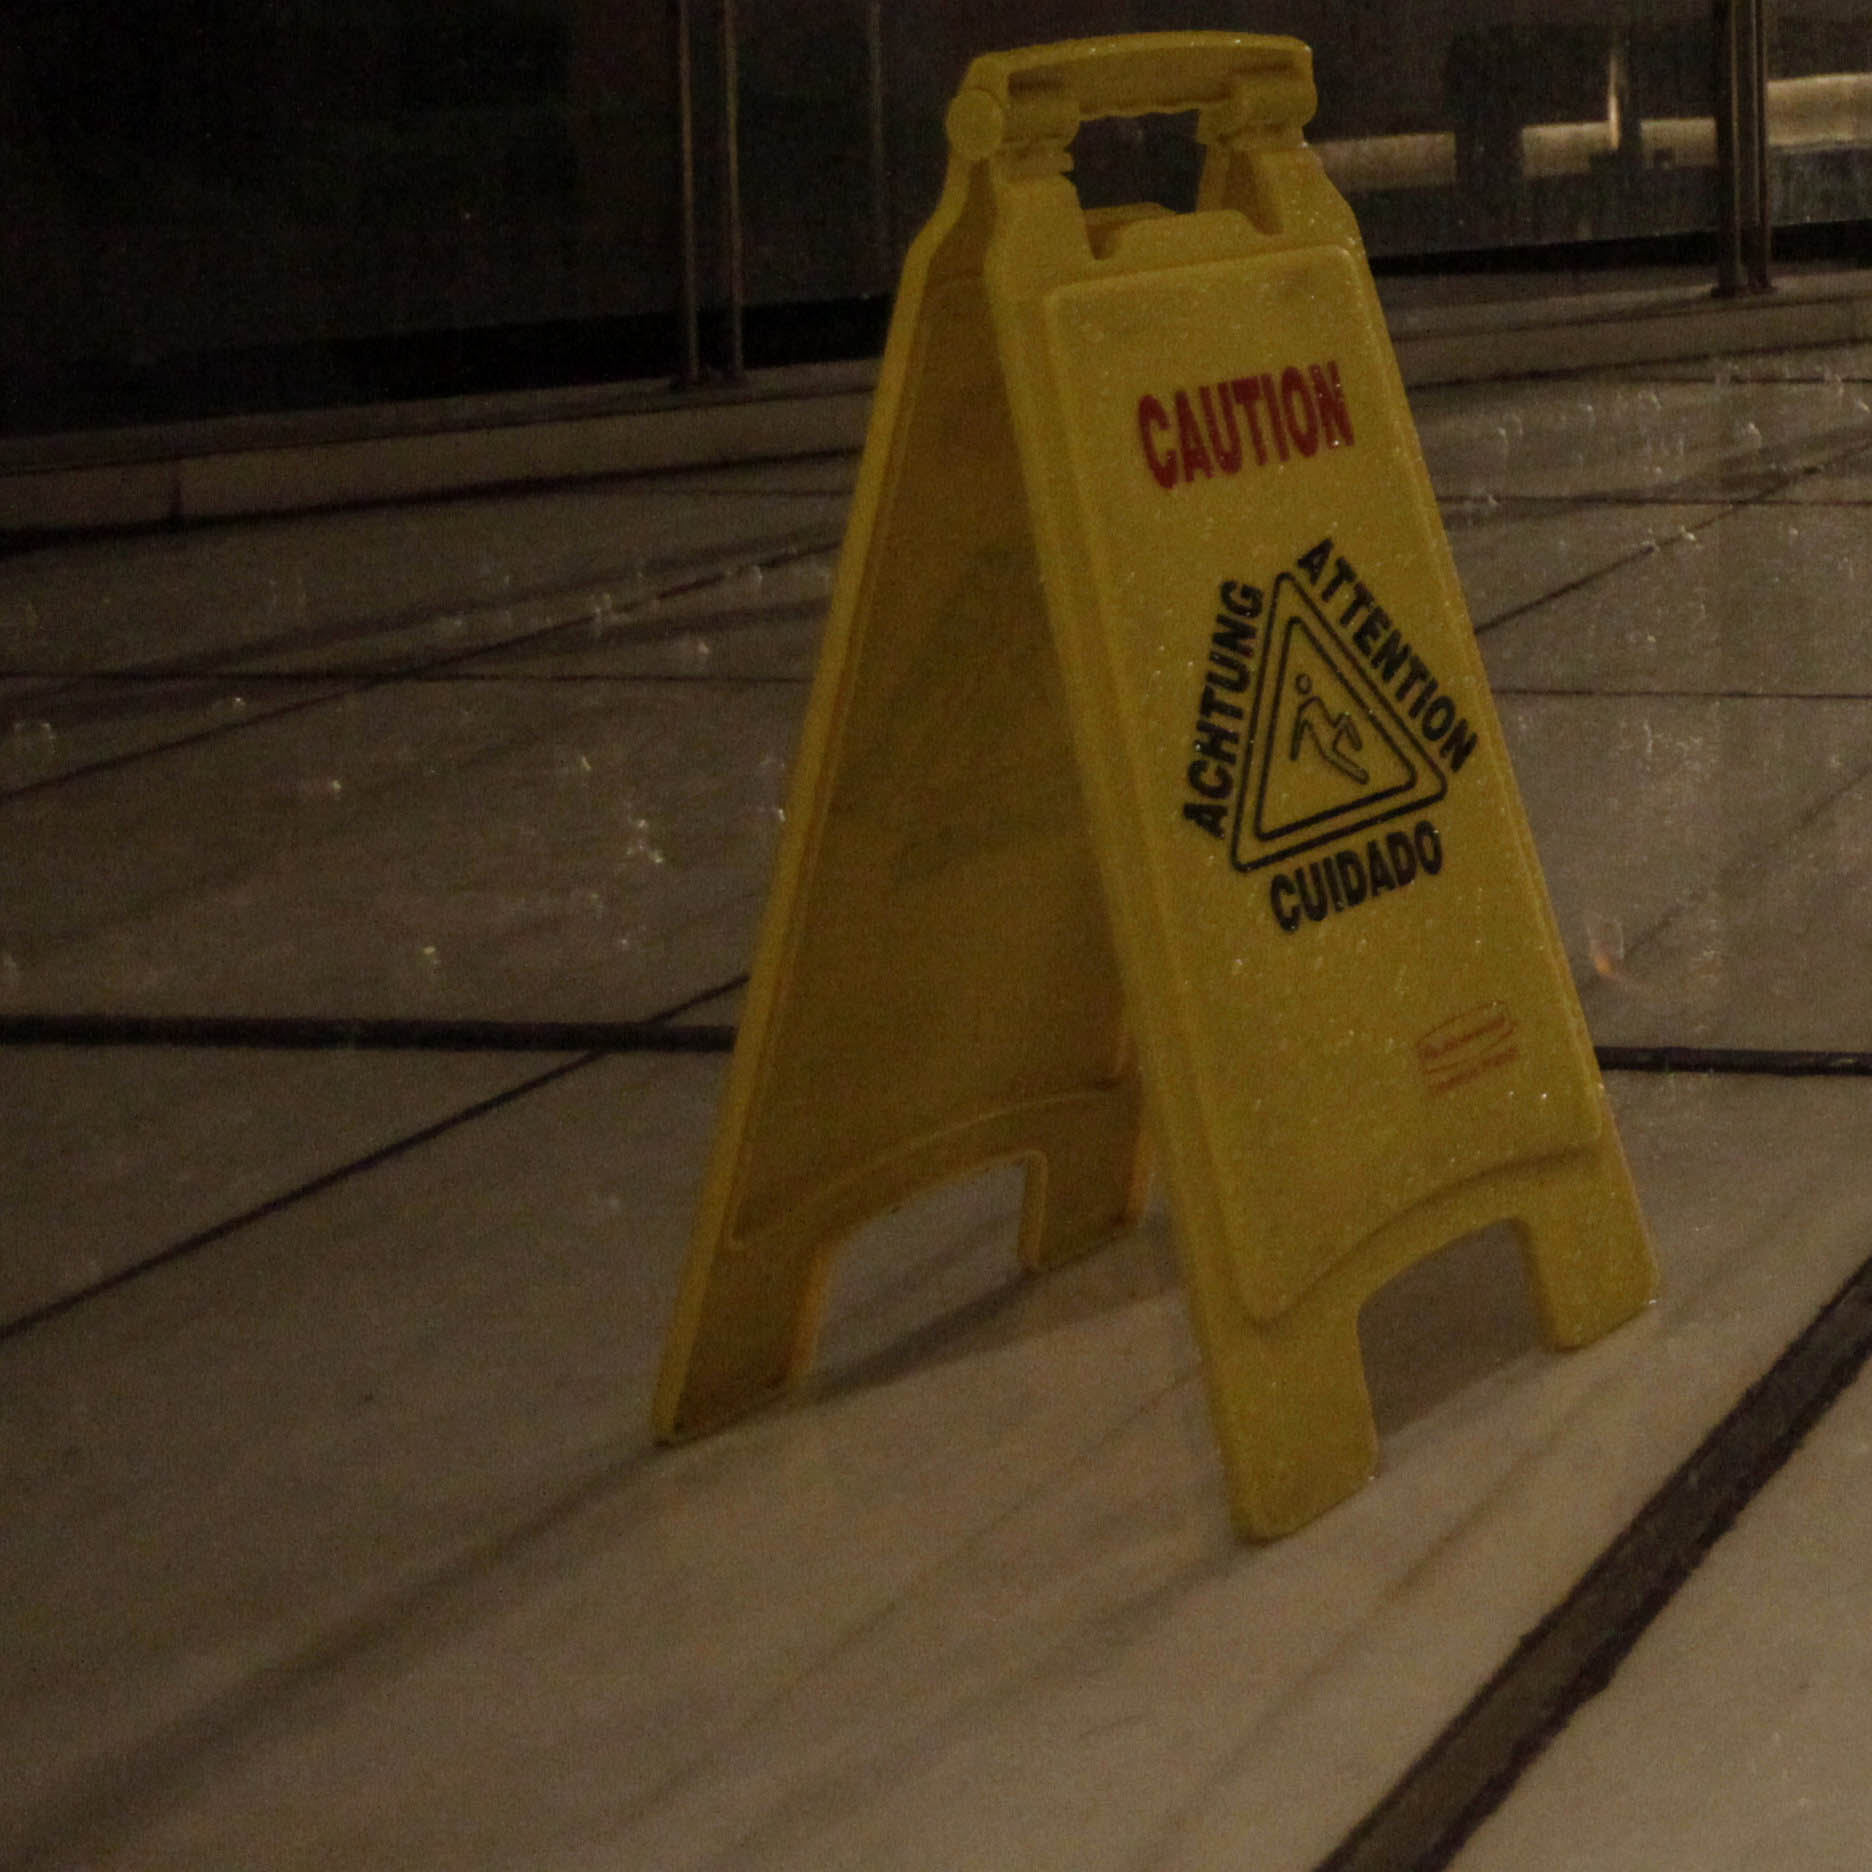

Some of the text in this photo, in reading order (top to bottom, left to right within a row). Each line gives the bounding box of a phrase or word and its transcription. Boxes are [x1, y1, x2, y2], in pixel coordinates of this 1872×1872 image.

[1137, 361, 1355, 490] CAUTION
[1181, 579, 1265, 840] ACHTUNG
[1296, 537, 1479, 774] ATTENTION
[1269, 819, 1443, 934] CUIDADO
